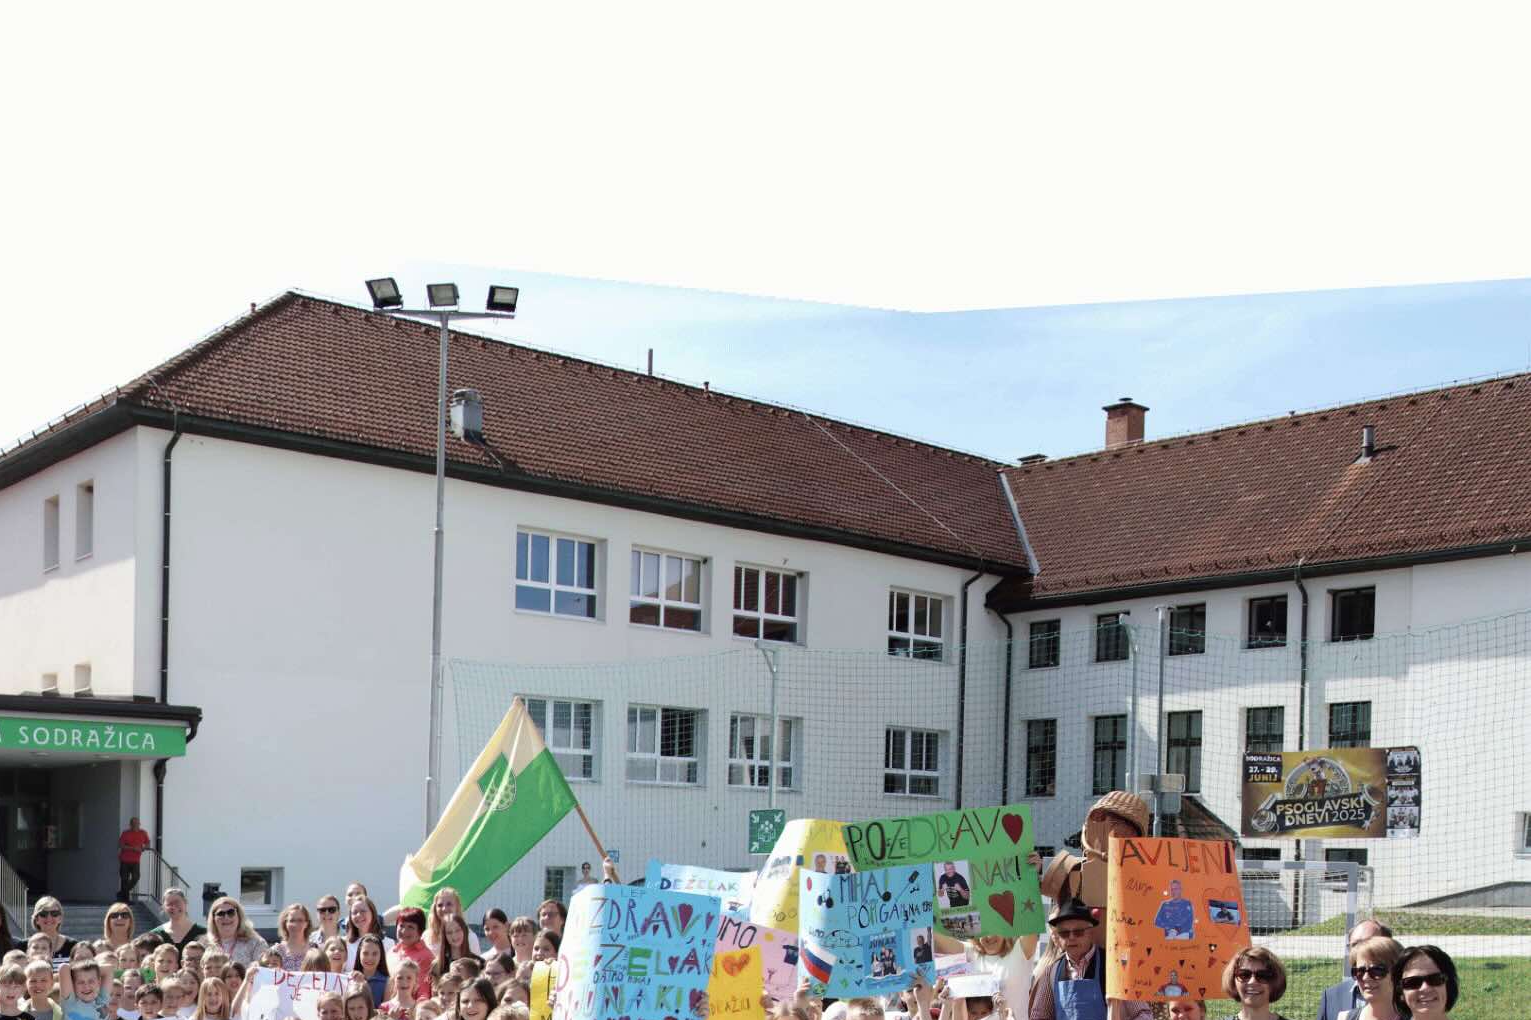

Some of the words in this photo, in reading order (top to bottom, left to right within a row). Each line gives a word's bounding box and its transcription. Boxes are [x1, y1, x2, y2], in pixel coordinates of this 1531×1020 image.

[18, 724, 156, 751] SODRAŽICA
[1247, 774, 1278, 782] JUNIJ
[1276, 798, 1365, 815] PSOGLAVSKI
[1285, 811, 1329, 826] DNEVI
[1332, 808, 1366, 823] 2025
[1120, 840, 1233, 875] AVLJENI
